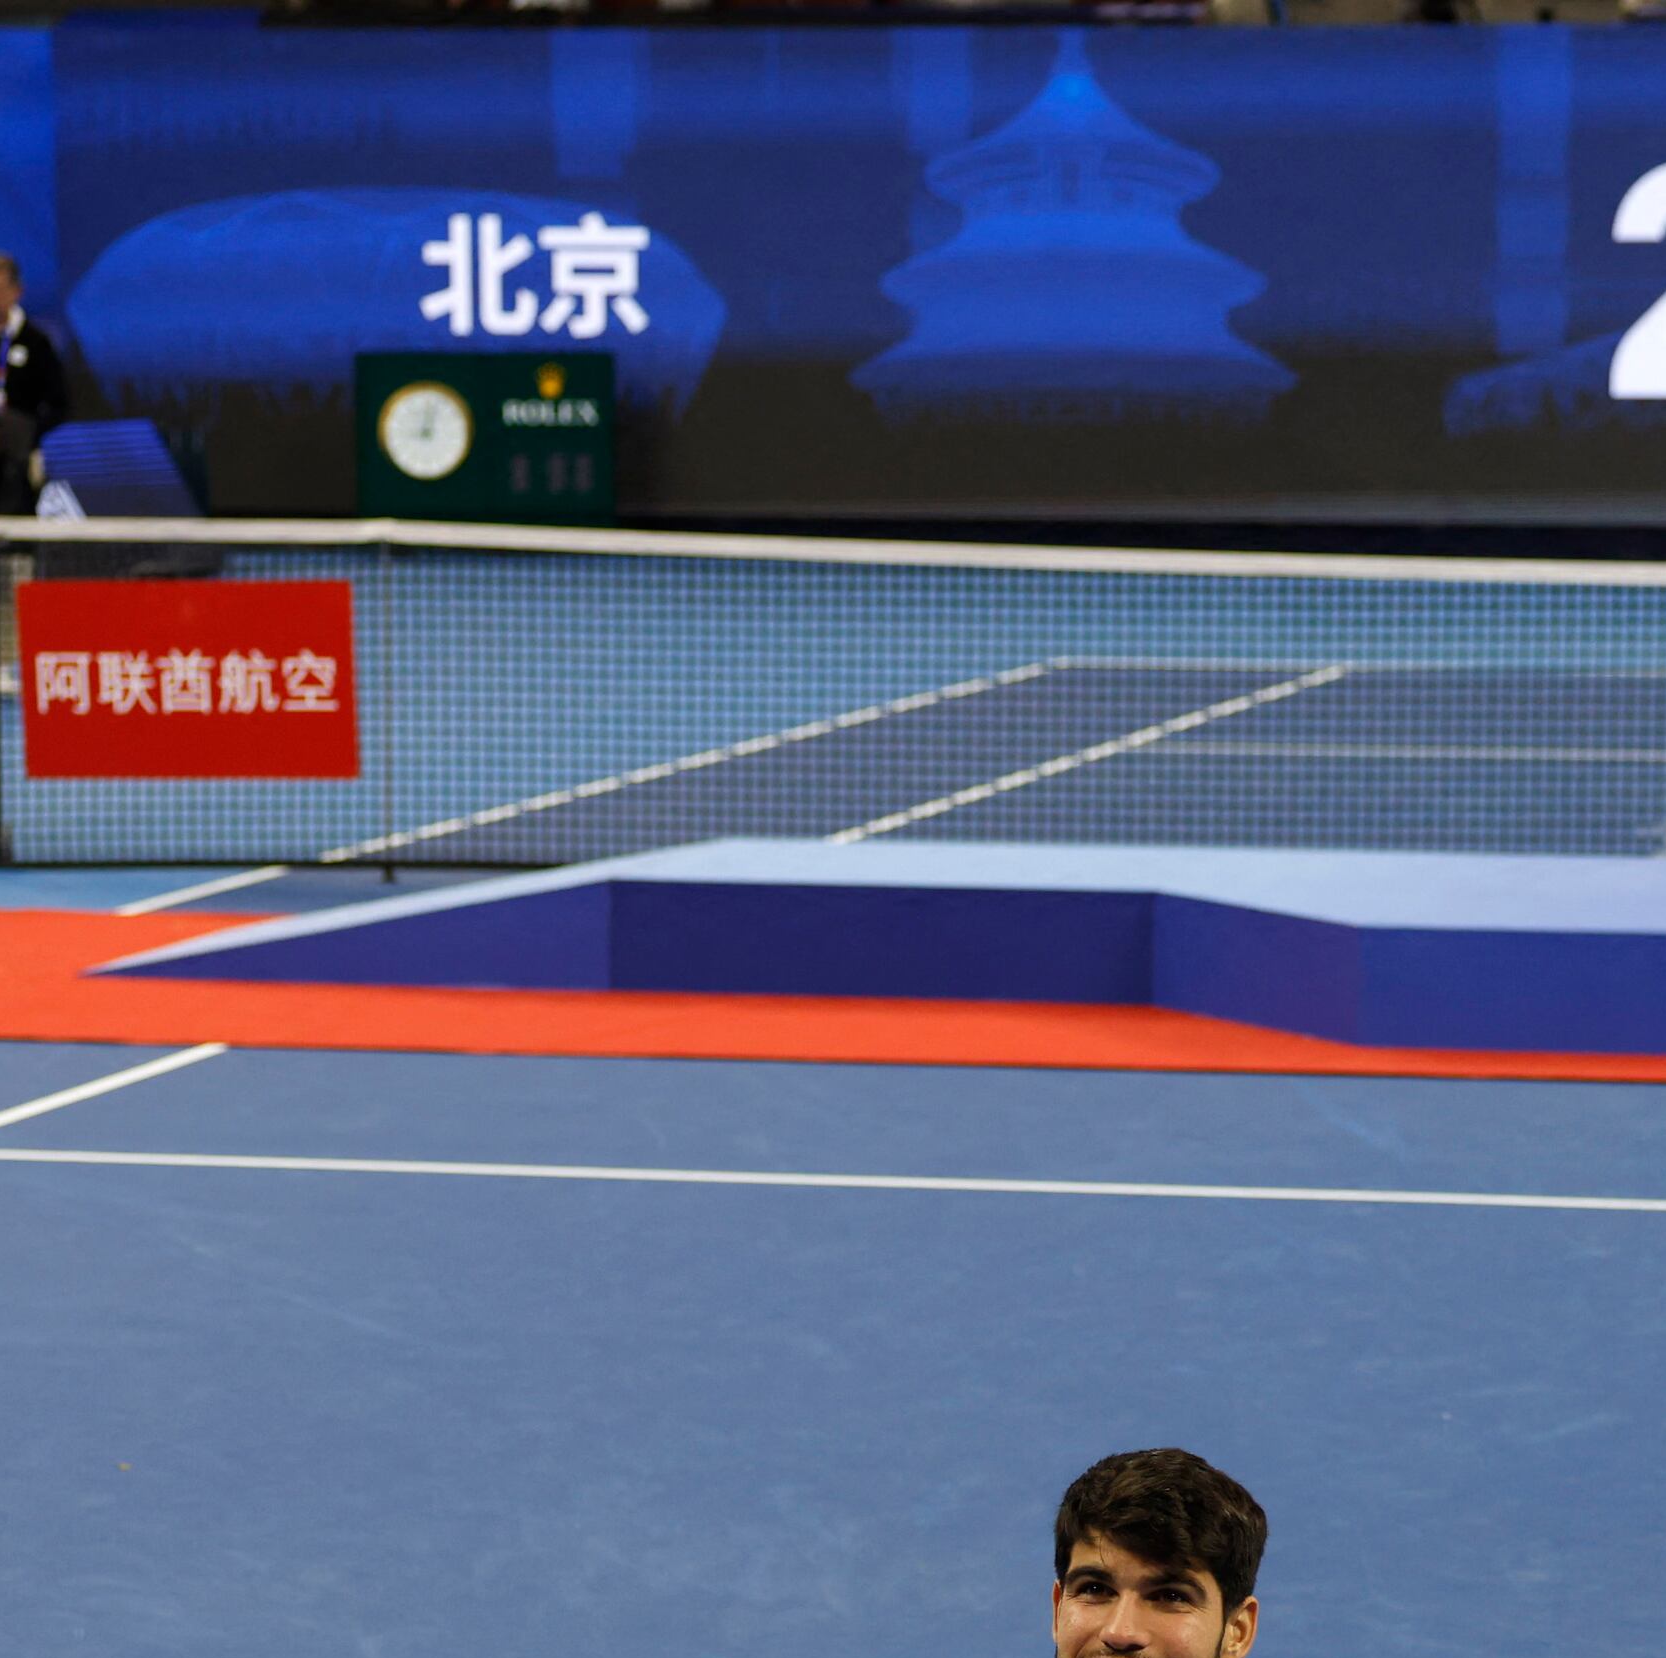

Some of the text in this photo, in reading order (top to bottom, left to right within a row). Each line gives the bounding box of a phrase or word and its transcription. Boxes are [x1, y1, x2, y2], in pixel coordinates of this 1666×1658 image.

[419, 212, 650, 340] 北京
[501, 399, 599, 427] ROLEX
[35, 648, 340, 716] 阿联酋航空
